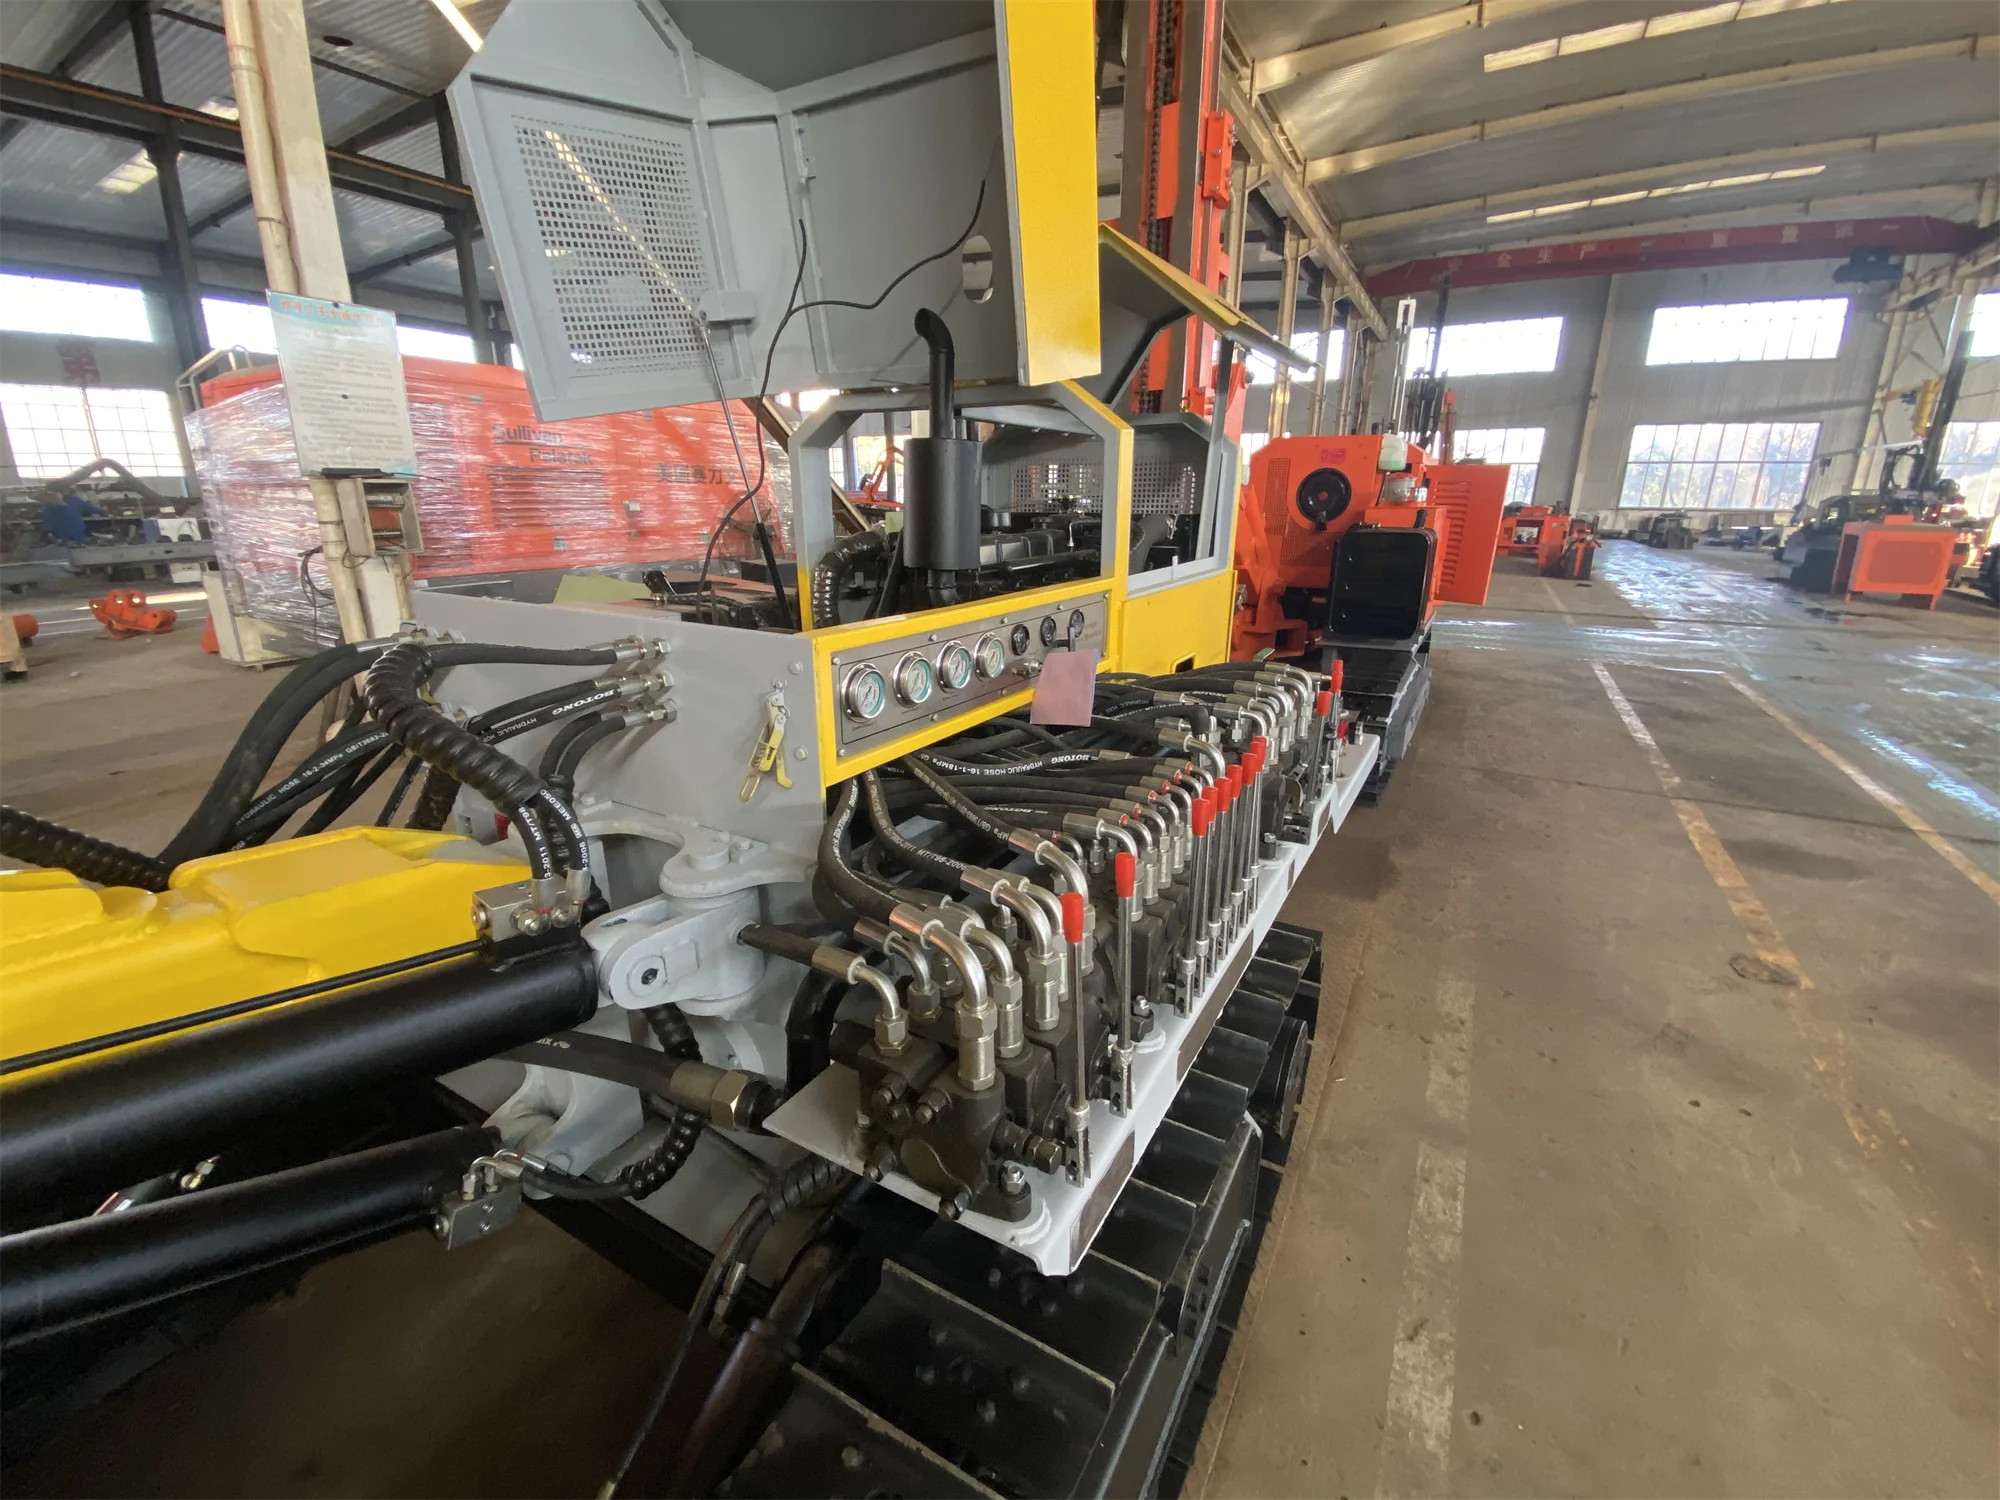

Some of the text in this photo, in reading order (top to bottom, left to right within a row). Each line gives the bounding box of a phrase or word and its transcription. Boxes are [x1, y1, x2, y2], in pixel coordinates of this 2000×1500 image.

[552, 690, 615, 715] BOTONG
[497, 717, 537, 737] HYDRAULIC
[932, 758, 980, 775] 16-1-18MPa
[1051, 754, 1090, 764] BOTONG
[983, 768, 1006, 776] HOSE
[1008, 760, 1042, 775] HYDRAULIC
[278, 778, 301, 794] HOSE
